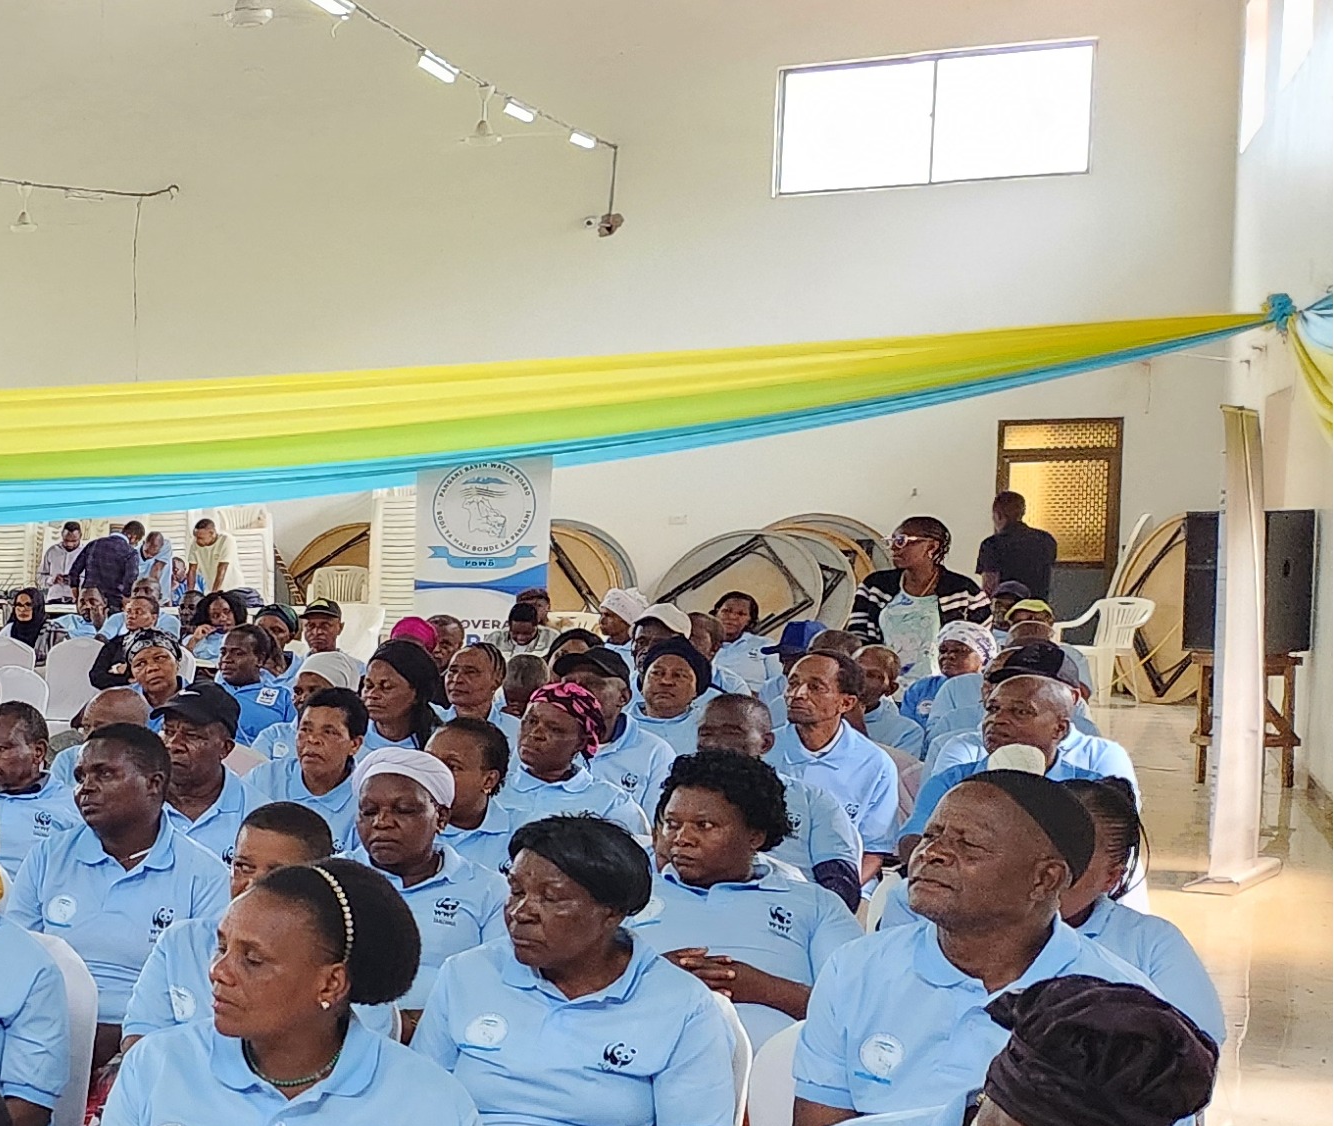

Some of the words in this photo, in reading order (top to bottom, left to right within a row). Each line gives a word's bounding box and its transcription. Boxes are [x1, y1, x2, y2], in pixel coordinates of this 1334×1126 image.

[438, 470, 464, 498] PANGANI
[464, 462, 488, 473] BASIN
[490, 463, 515, 476] WATER
[514, 474, 531, 496] BOARD
[436, 510, 447, 530] BODI
[444, 529, 453, 539] YA
[453, 538, 470, 550] MAJI
[500, 539, 511, 548] LA
[510, 510, 532, 541] PANGANI
[434, 910, 458, 919] WWF
[768, 921, 792, 933] WWF
